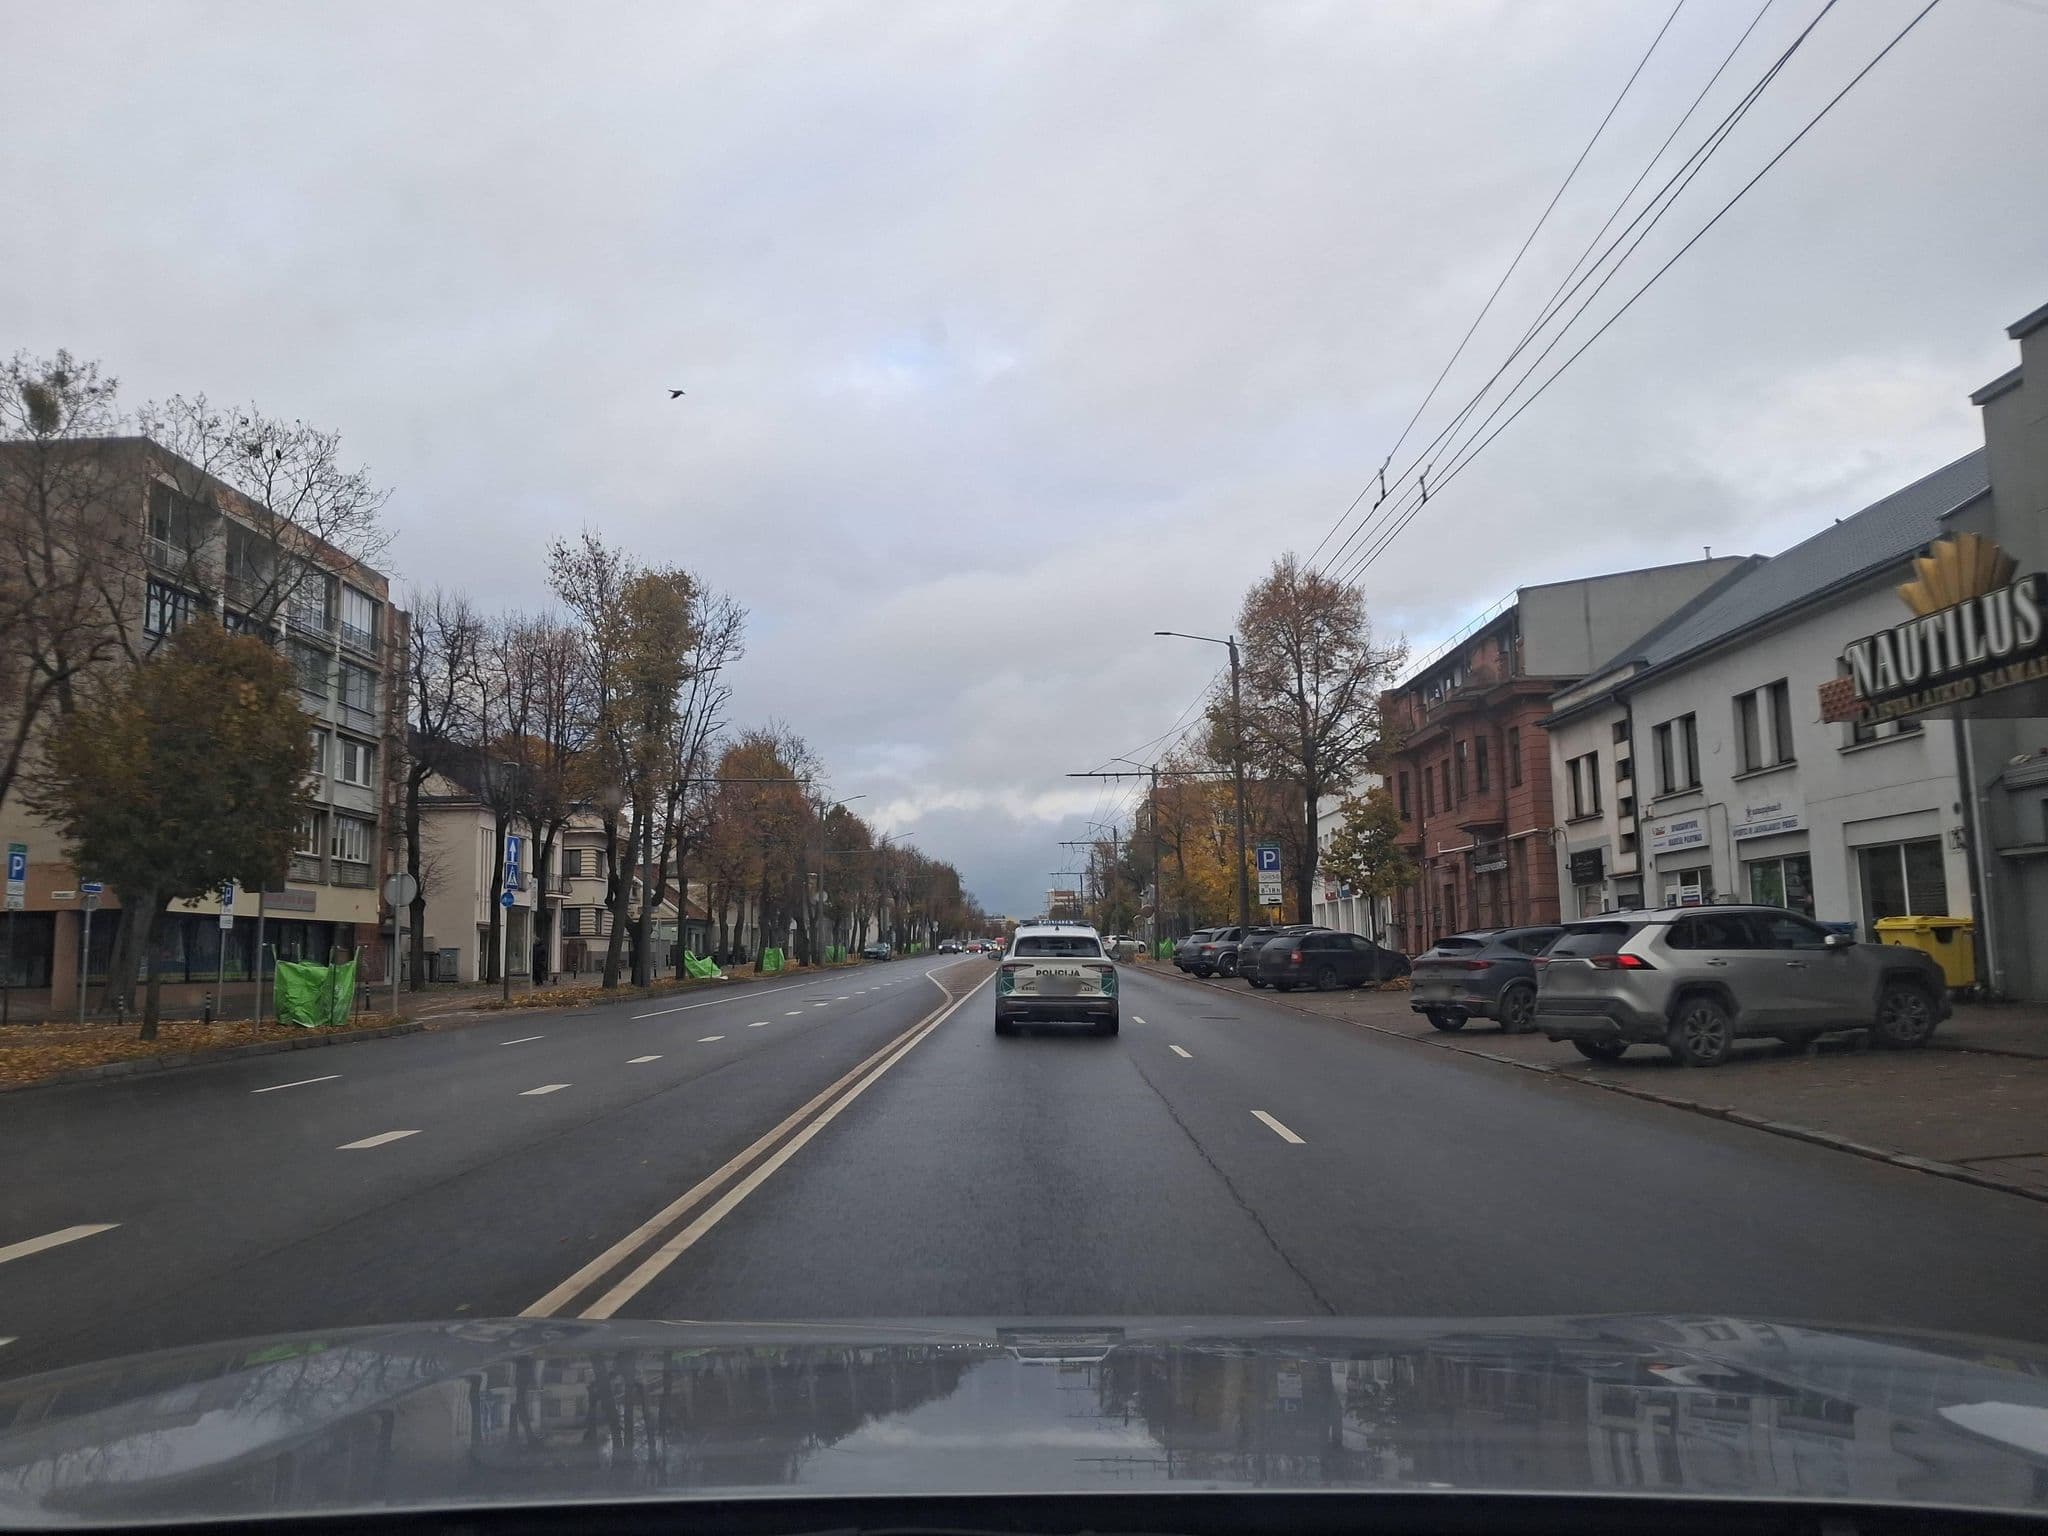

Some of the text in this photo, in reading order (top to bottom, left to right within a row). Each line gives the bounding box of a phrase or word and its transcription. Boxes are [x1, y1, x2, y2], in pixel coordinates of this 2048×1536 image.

[1844, 580, 2042, 698] NAUTILUS
[12, 855, 24, 878] P
[1264, 850, 1276, 869] P
[1035, 969, 1081, 977] POLICIJA
